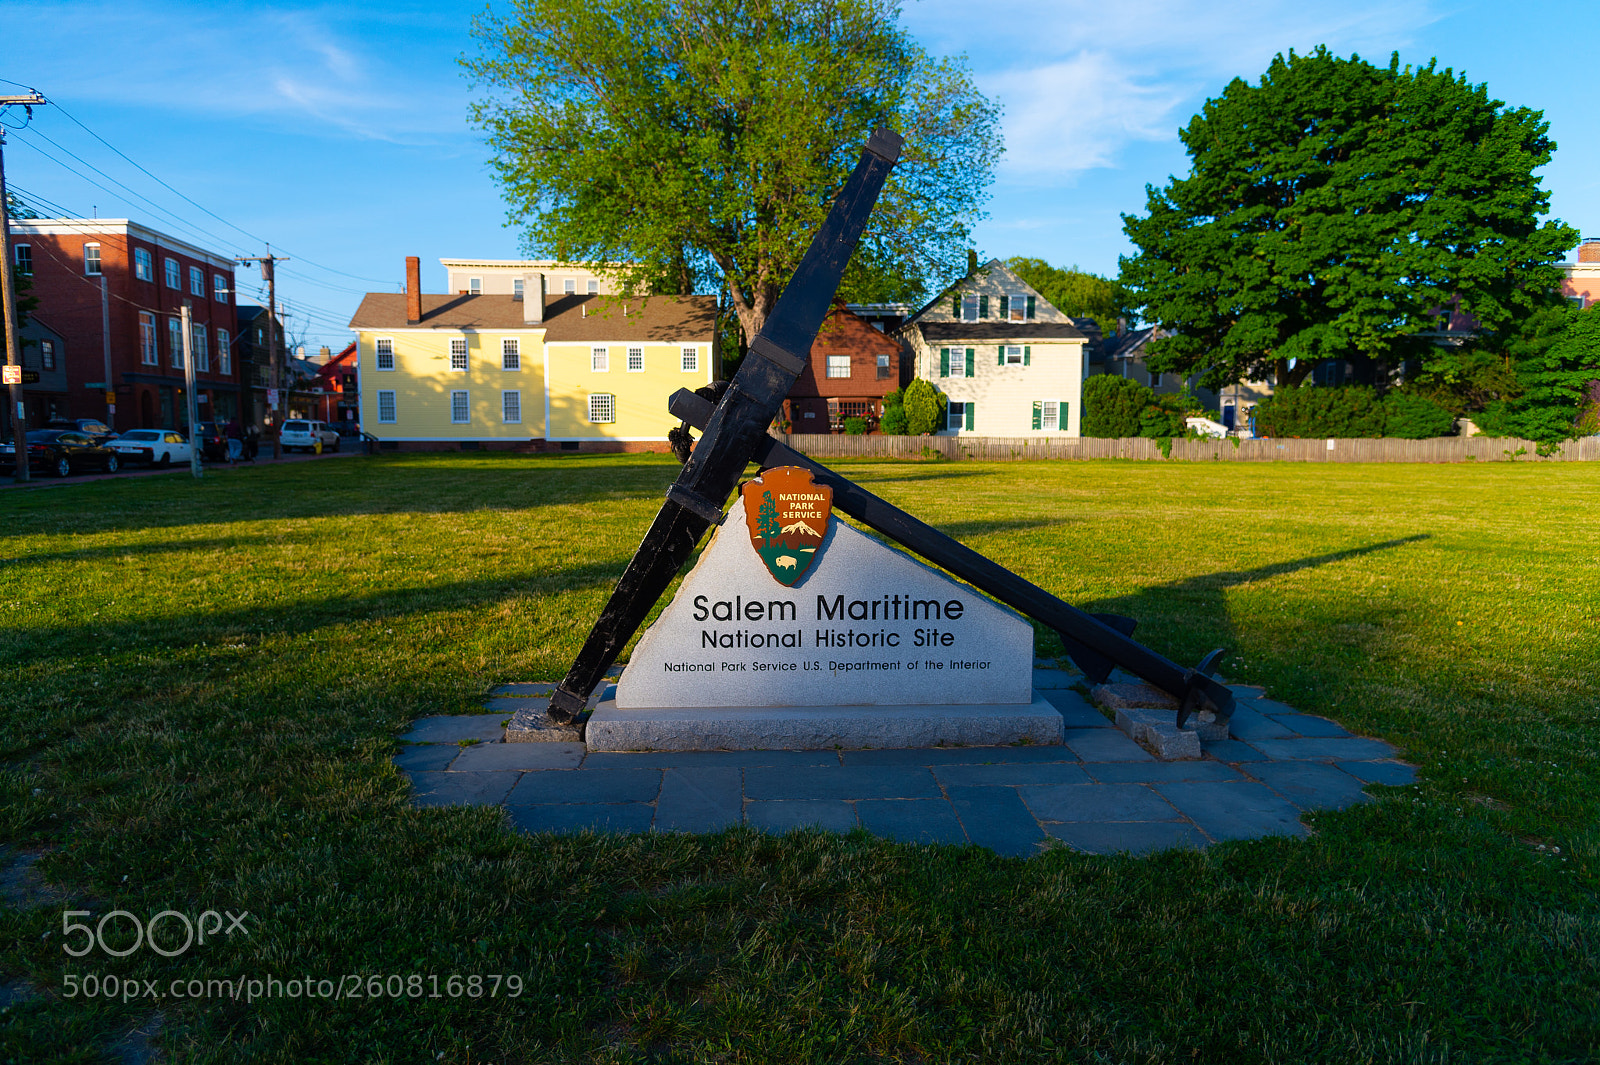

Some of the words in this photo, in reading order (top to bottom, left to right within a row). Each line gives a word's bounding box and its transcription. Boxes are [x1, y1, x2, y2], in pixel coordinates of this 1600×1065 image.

[779, 493, 826, 501] NATIONAL
[789, 502, 815, 510] PARK
[782, 511, 822, 519] SERVICE
[692, 595, 797, 621] Salem
[816, 594, 964, 620] Maritime
[701, 629, 802, 648] National
[815, 629, 901, 647] Historic
[913, 629, 955, 647] Site
[664, 661, 716, 672] National
[721, 661, 747, 672] Park
[752, 661, 797, 672] Service
[803, 661, 823, 671] U.S.
[828, 660, 901, 673] Department
[906, 660, 919, 670] of
[924, 659, 944, 670] the
[949, 659, 991, 670] Interior
